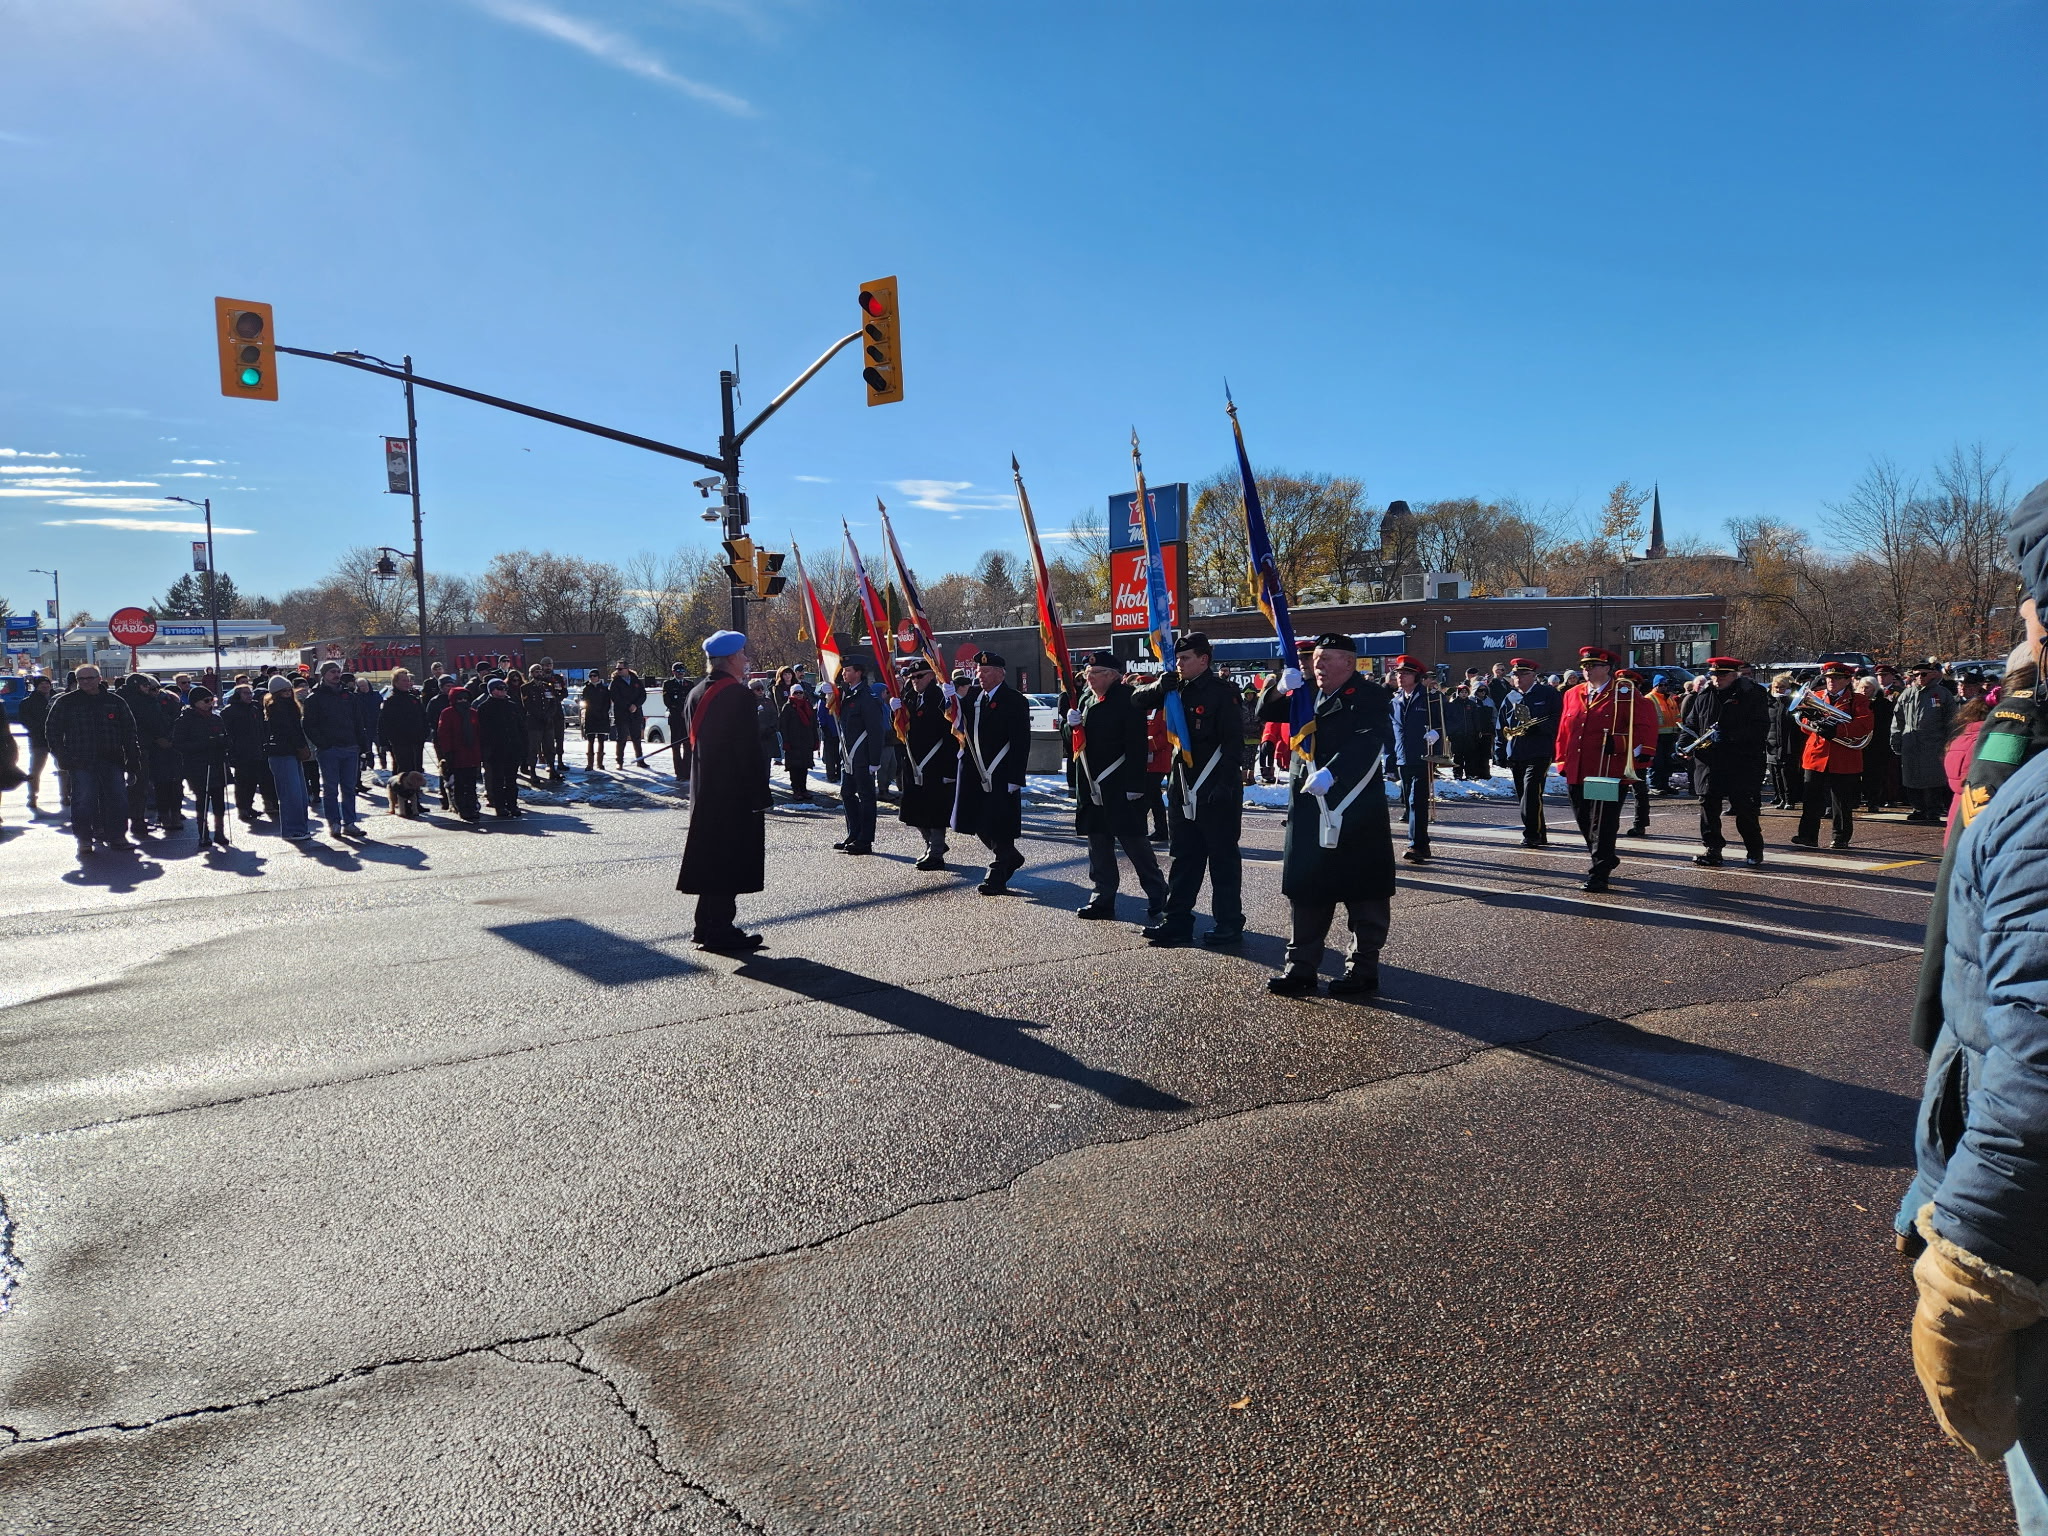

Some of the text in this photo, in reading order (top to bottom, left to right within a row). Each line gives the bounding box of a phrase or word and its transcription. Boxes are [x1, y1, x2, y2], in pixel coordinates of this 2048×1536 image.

[1132, 555, 1149, 581] Ti
[1115, 582, 1173, 609] Horts
[1115, 612, 1145, 627] DRIVE
[164, 627, 204, 635] STINSON
[1633, 626, 1665, 641] Kushys
[1126, 659, 1165, 675] Kushys
[1995, 711, 2026, 722] CANADA
